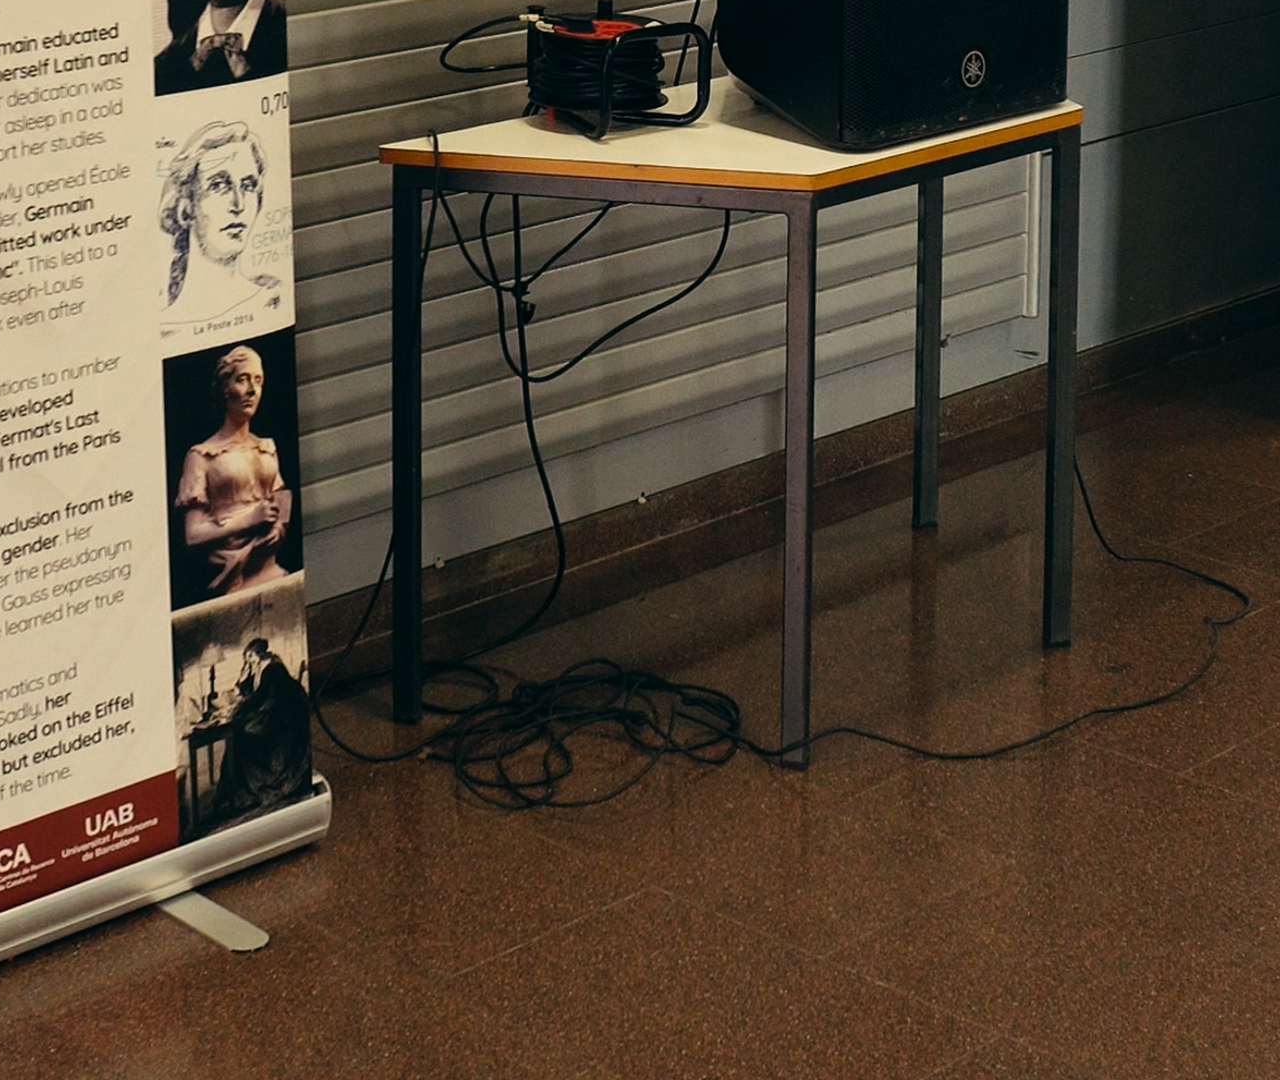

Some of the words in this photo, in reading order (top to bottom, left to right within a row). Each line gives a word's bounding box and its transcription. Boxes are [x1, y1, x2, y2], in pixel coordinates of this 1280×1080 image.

[260, 91, 289, 117] 0,70
[1, 754, 30, 776] but
[32, 727, 102, 765] excluded
[105, 720, 136, 741] her,
[85, 802, 134, 837] UAB
[61, 835, 111, 858] Universitat
[82, 851, 94, 862] de
[95, 835, 140, 857] Barcelona
